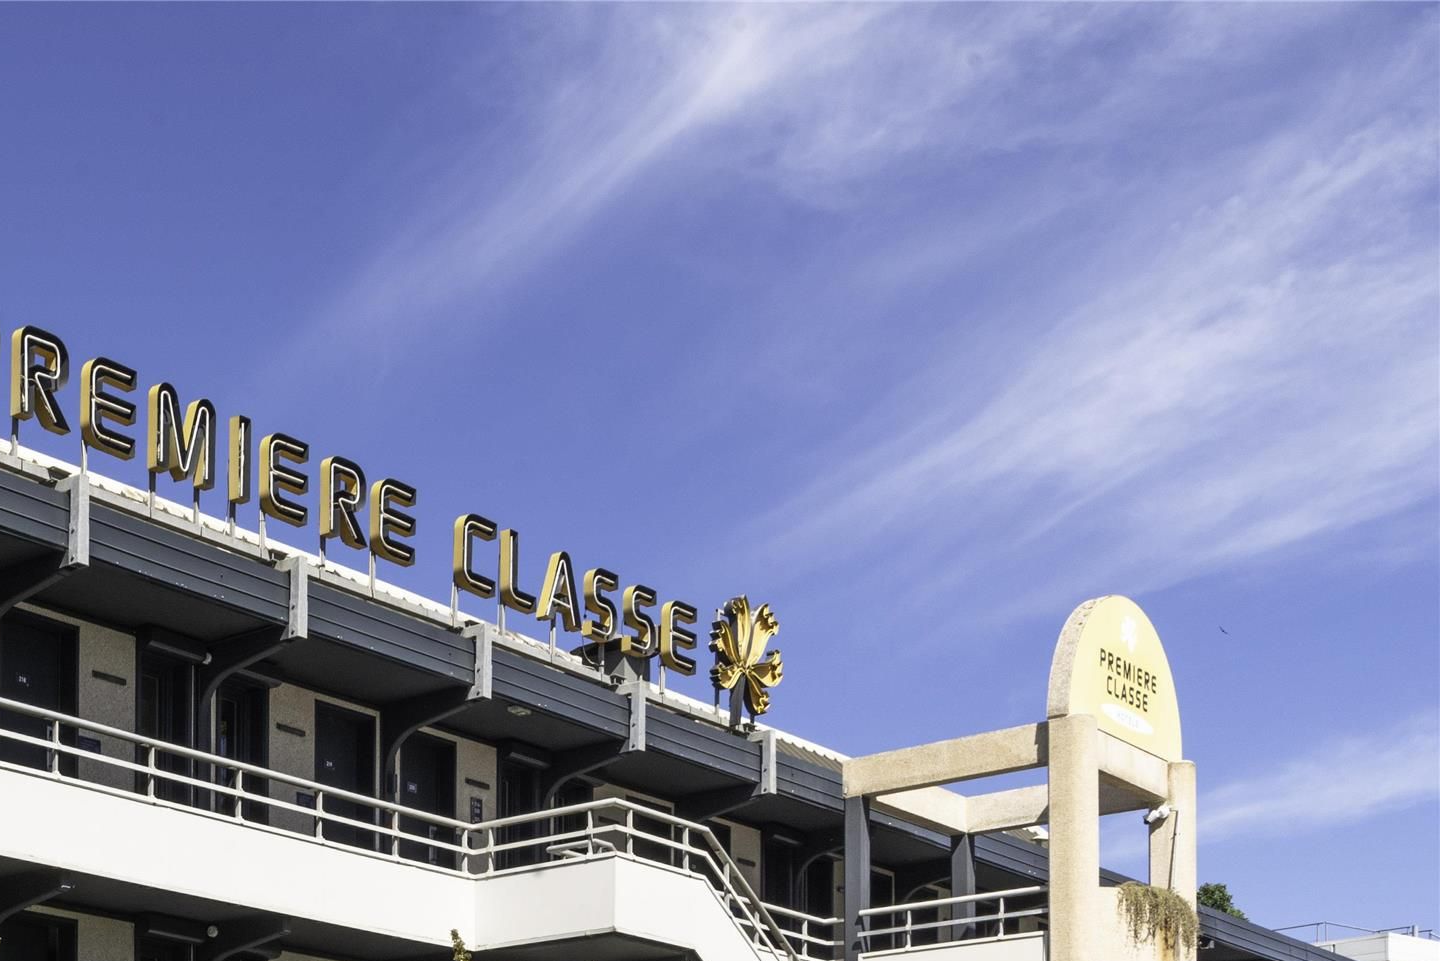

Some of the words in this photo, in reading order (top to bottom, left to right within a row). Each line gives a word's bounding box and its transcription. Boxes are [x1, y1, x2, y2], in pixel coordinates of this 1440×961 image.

[453, 513, 698, 677] CLASSE
[1099, 647, 1157, 694] PREMIERE
[1106, 675, 1149, 713] CLASSE
